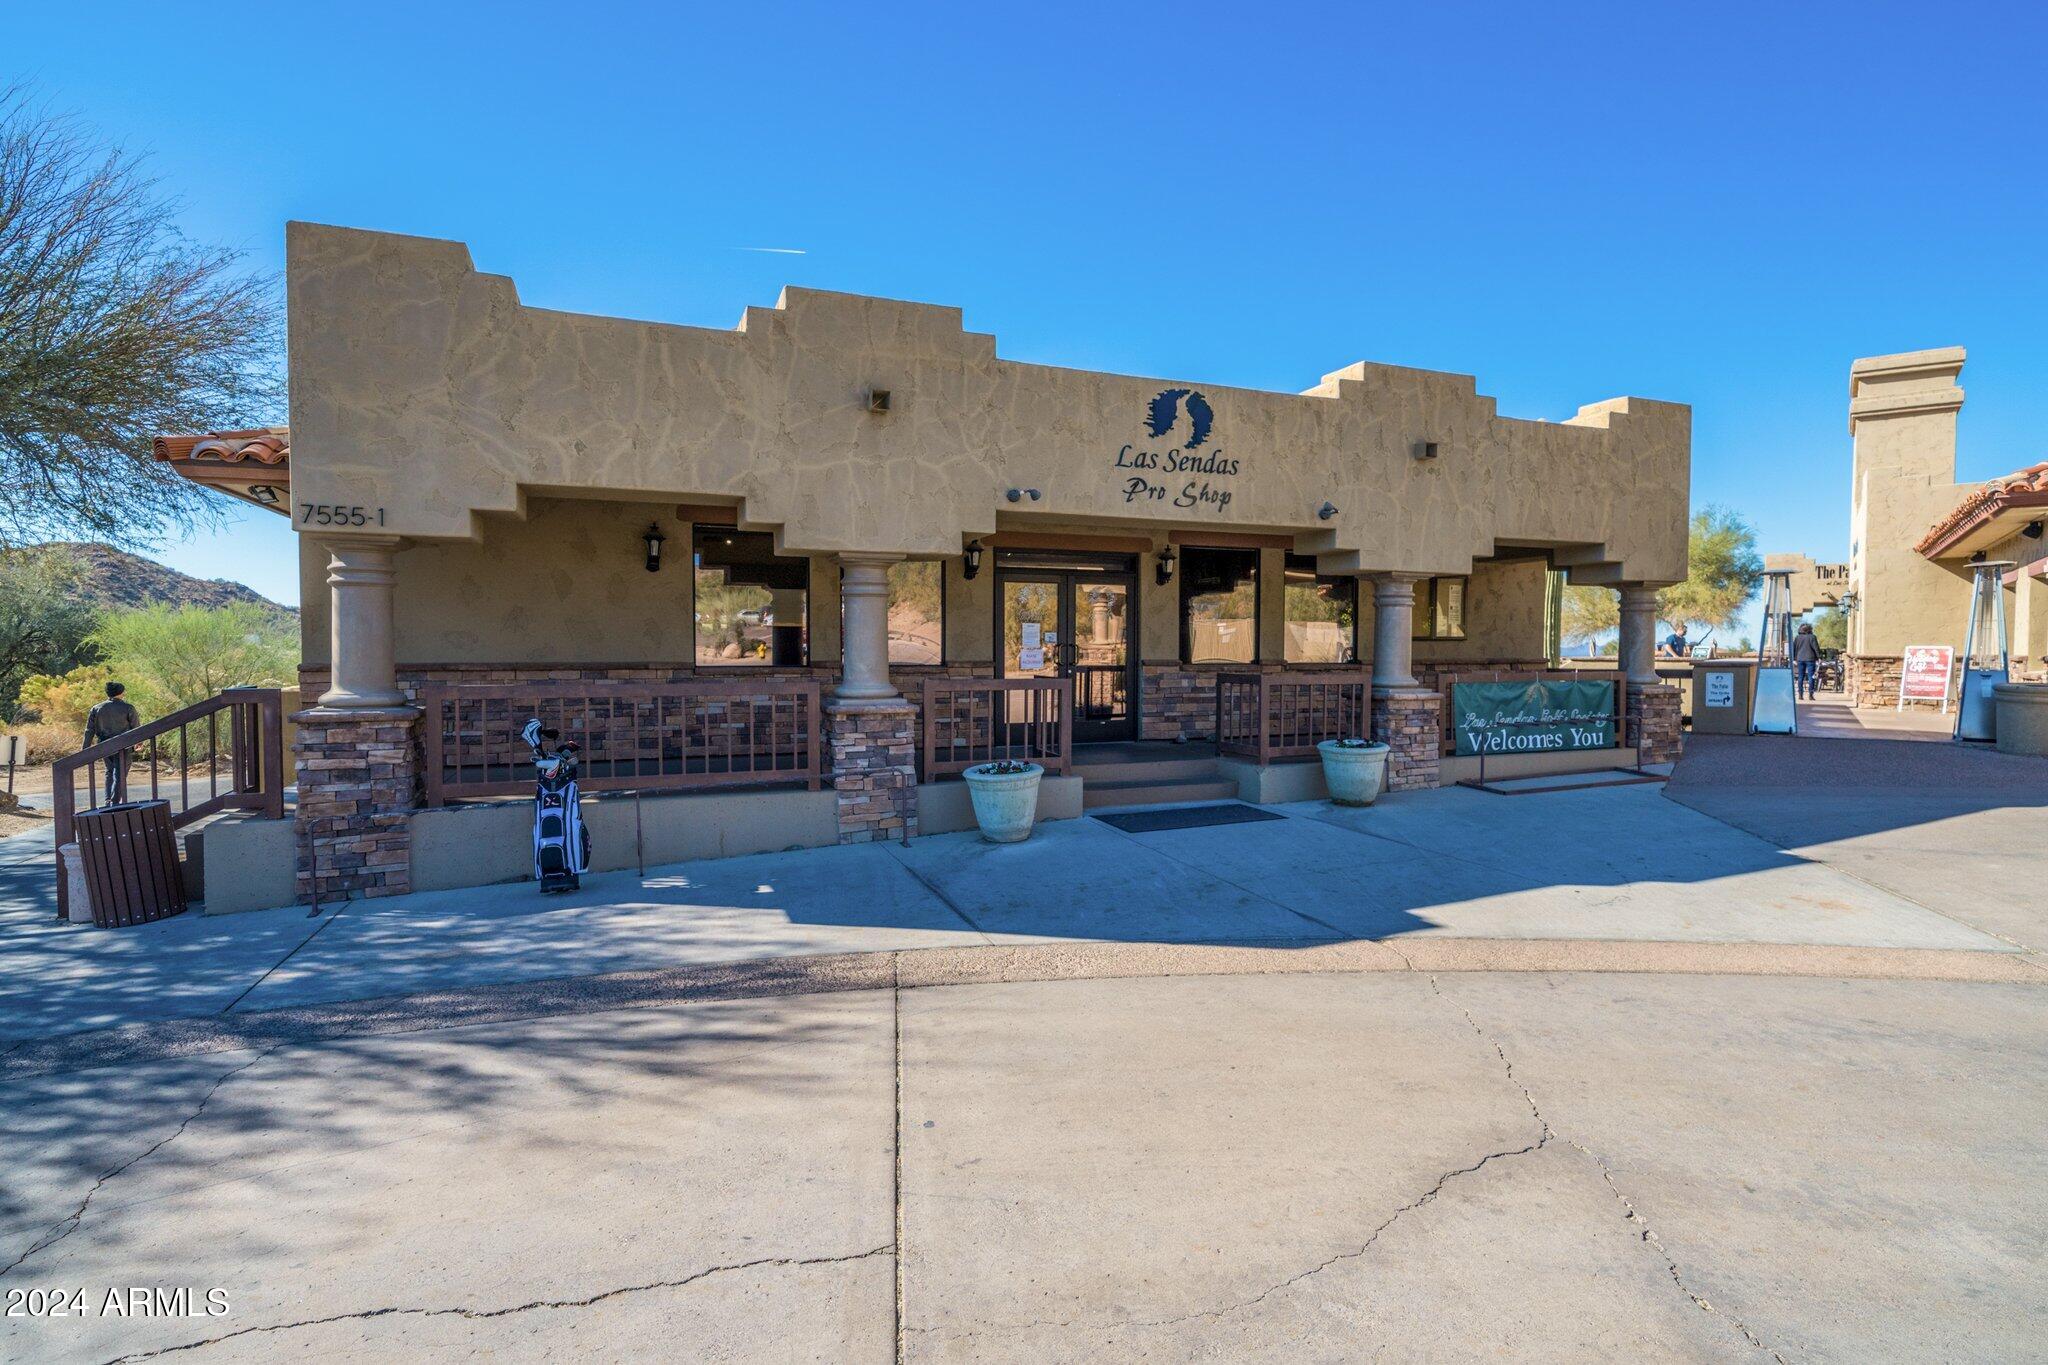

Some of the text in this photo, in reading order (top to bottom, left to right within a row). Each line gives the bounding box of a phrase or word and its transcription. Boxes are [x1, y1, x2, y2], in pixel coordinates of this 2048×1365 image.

[1114, 445, 1239, 476] Las Sendas
[1122, 477, 1232, 513] Pro Shop
[300, 504, 384, 527] 7555-1
[1815, 565, 1835, 579] The
[1467, 728, 1604, 752] Welcomes You
